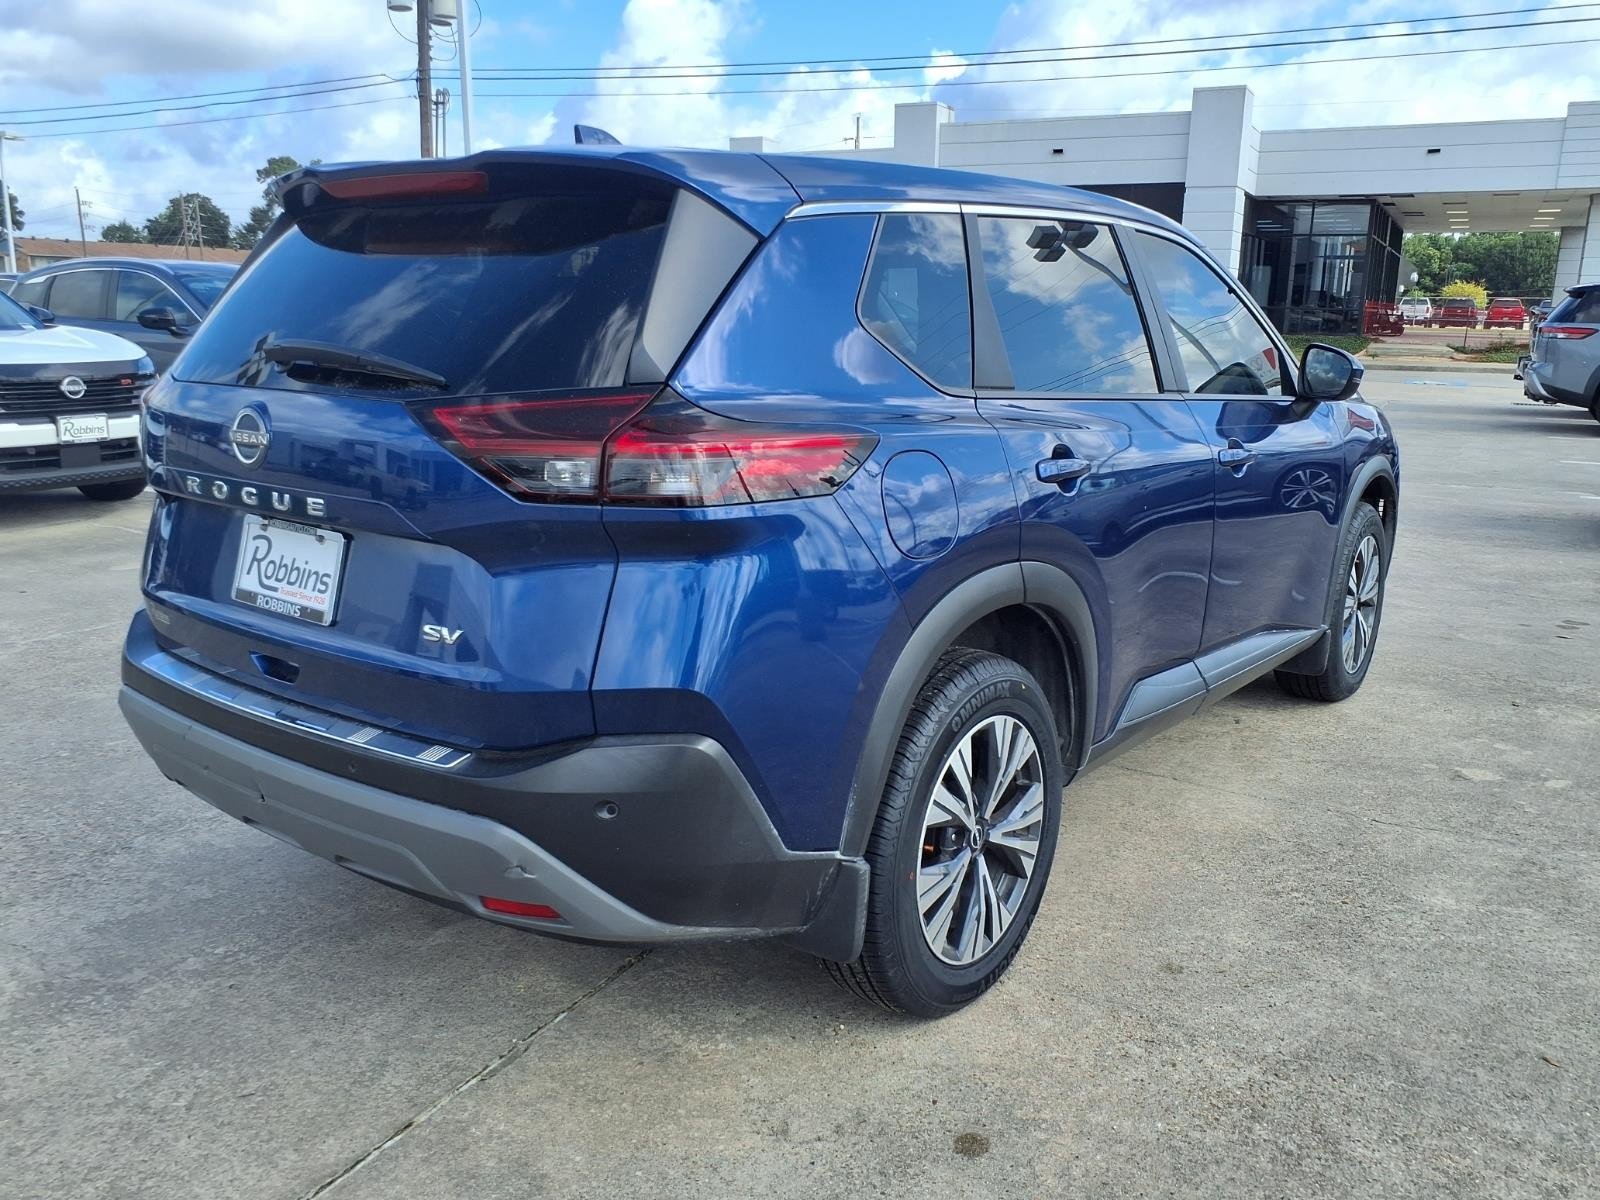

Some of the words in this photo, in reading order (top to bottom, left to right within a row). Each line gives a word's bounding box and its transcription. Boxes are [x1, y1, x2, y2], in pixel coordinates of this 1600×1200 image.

[63, 421, 105, 438] Robbins
[186, 475, 325, 517] ROGUE
[246, 534, 332, 595] Robbins
[256, 594, 302, 617] ROBBINS
[423, 624, 464, 645] SV
